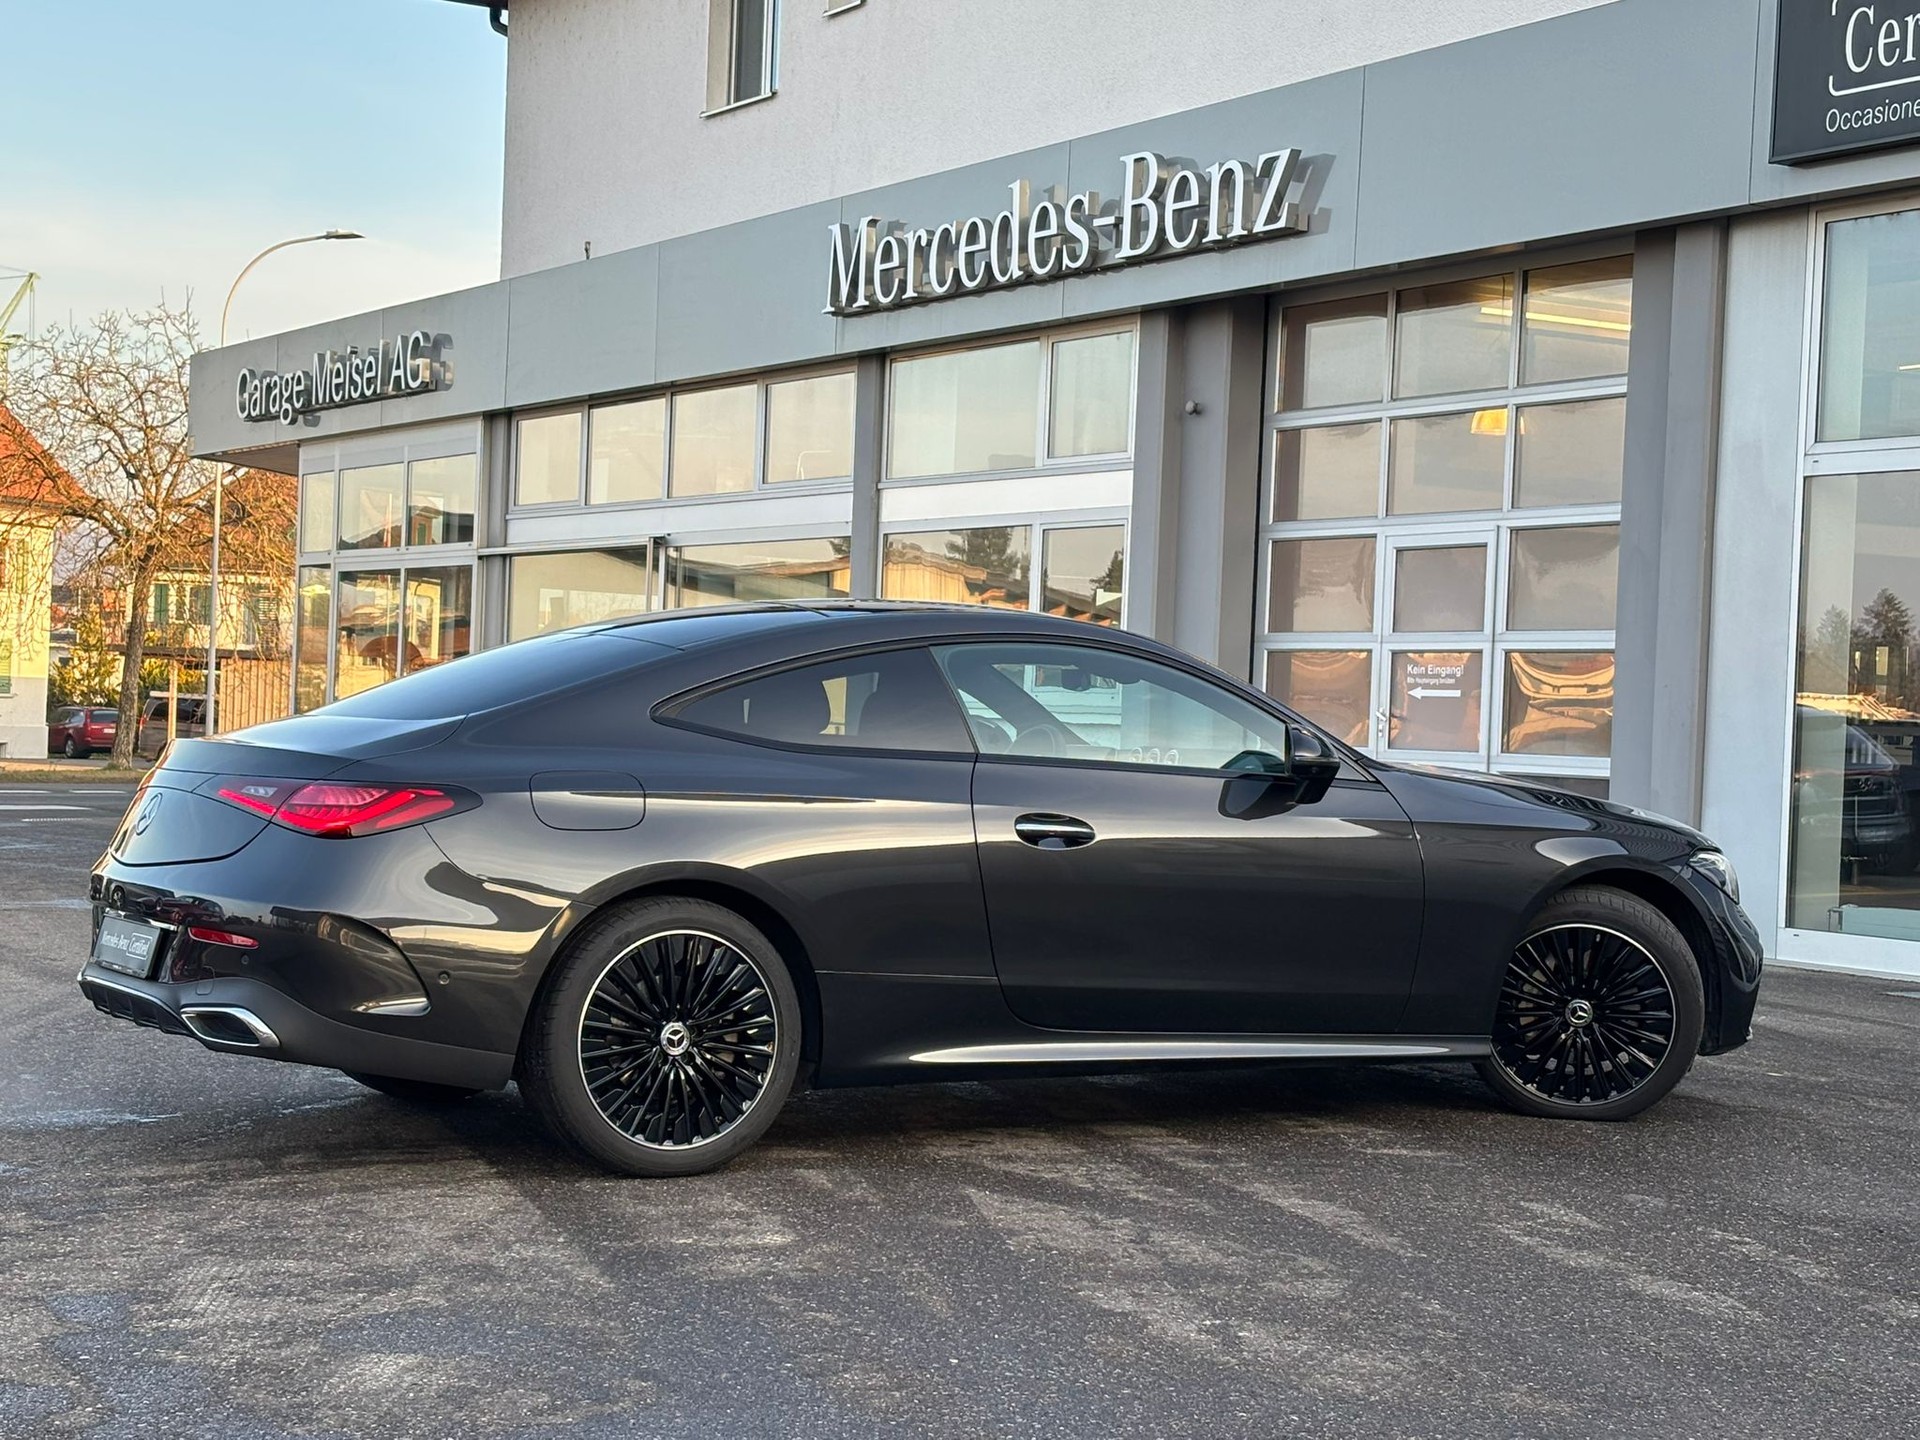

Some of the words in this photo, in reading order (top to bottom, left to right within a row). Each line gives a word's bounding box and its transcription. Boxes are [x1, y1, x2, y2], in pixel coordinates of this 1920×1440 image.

[822, 147, 1303, 315] Mercedes-Benz
[236, 367, 306, 425] Garage
[312, 339, 386, 405] Meisel
[388, 330, 430, 394] AG
[1407, 664, 1426, 675] Kein
[1427, 664, 1464, 677] Eingang!
